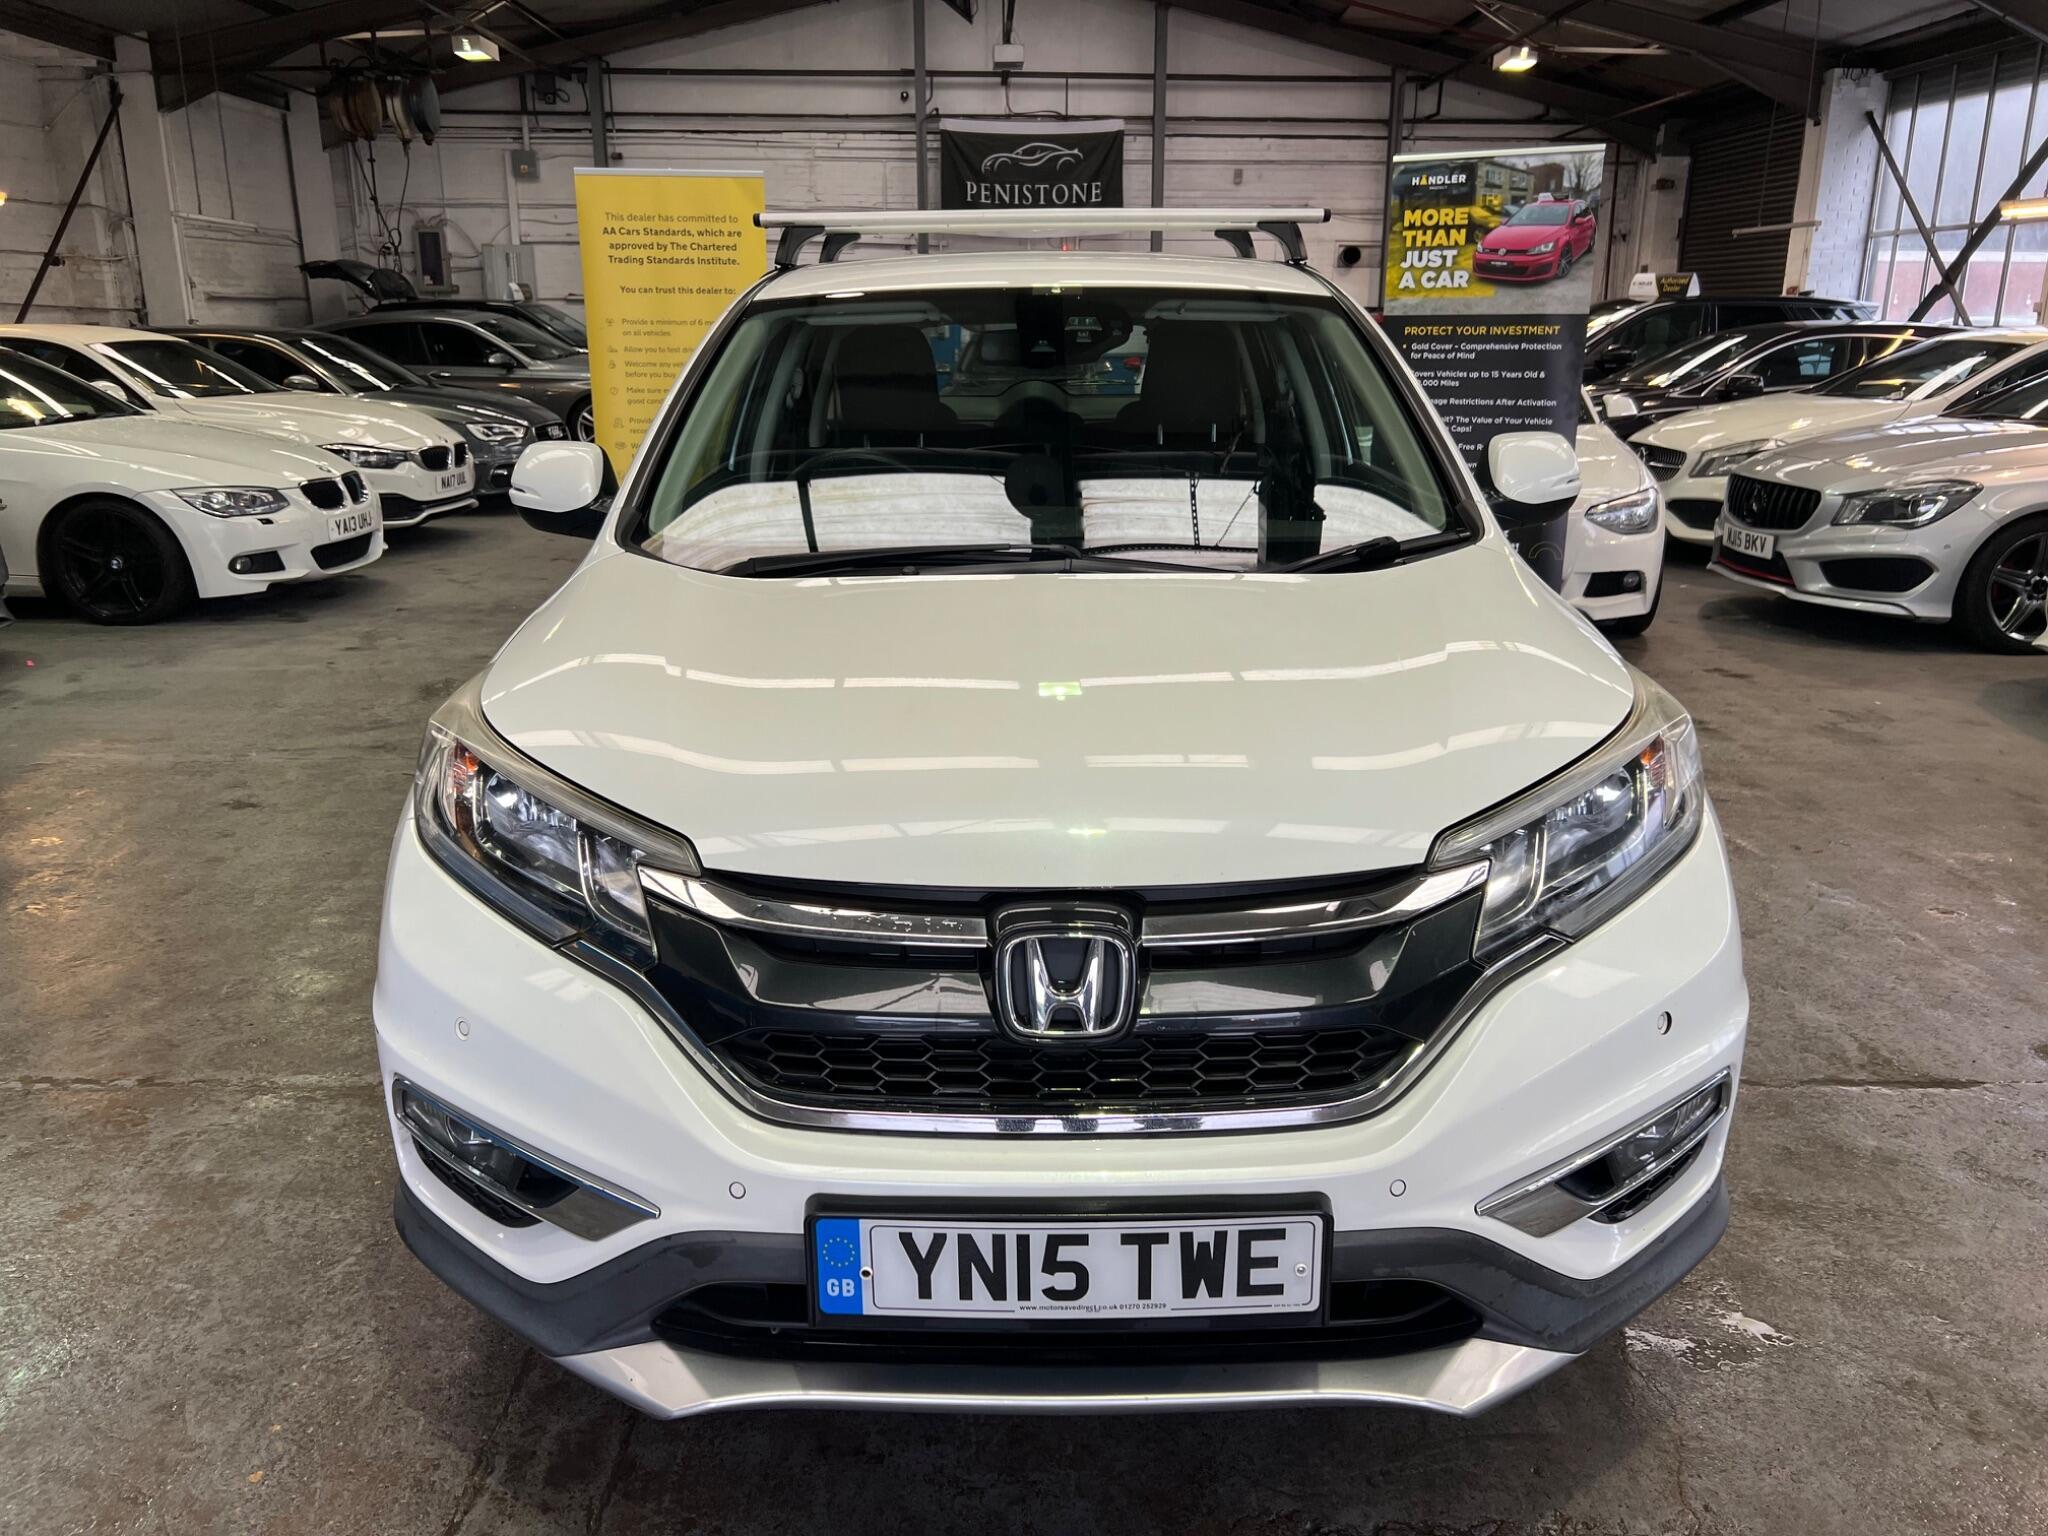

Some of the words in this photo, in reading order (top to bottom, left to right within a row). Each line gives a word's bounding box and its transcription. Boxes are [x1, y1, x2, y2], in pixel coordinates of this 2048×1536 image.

[1412, 174, 1467, 186] HANDLER
[965, 181, 1102, 205] PENISTONE
[604, 212, 625, 222] This
[626, 213, 656, 222] dealer
[658, 213, 674, 223] has
[676, 214, 726, 223] committed
[728, 215, 738, 224] to
[1403, 207, 1469, 227] MORE
[602, 227, 617, 236] AA
[618, 227, 641, 236] Cars
[643, 227, 695, 238] Standards,
[697, 229, 725, 238] which
[727, 230, 742, 238] are
[1402, 228, 1467, 248] THAN
[609, 242, 655, 252] approved
[656, 242, 668, 252] by
[669, 242, 687, 251] The
[690, 243, 737, 252] Chartered
[608, 255, 644, 265] Trading
[646, 256, 695, 265] Standards
[697, 256, 740, 266] Institute.
[1400, 249, 1458, 268] JUST
[1399, 271, 1415, 289] A
[1420, 270, 1470, 289] CAR
[620, 285, 636, 294] You
[655, 286, 676, 295] trust
[678, 286, 693, 295] this
[695, 286, 722, 295] dealer
[724, 286, 736, 295] to:
[621, 318, 648, 326] Provide
[689, 318, 697, 326] of
[697, 318, 703, 326] 6
[643, 329, 671, 337] vehicles
[1404, 326, 1453, 336] PROTECT
[1456, 326, 1487, 336] YOUR
[1489, 325, 1561, 335] INVESTMENT
[1411, 342, 1430, 351] Gold
[1431, 342, 1452, 351] Cover
[1460, 342, 1519, 352] Comprehensive
[1521, 342, 1562, 351] Protection
[1410, 351, 1421, 360] for
[1423, 352, 1445, 360] Peace
[1447, 351, 1455, 360] of
[1457, 351, 1475, 360] Mind
[1412, 370, 1434, 378] overs
[1436, 370, 1467, 378] Vehicles
[1469, 371, 1479, 380] up
[1480, 370, 1489, 378] to
[1491, 370, 1499, 378] 15
[1501, 370, 1522, 378] Years
[1523, 370, 1537, 378] Old
[1440, 379, 1460, 387] Miles
[1449, 397, 1494, 406] Restrictions
[1495, 398, 1516, 406] After
[1517, 398, 1557, 407] Activation
[1456, 416, 1469, 424] The
[1472, 416, 1492, 424] Value
[1494, 416, 1503, 424] of
[1504, 417, 1522, 425] Your
[1524, 417, 1553, 426] Vehicle
[334, 515, 357, 536] YA13
[1744, 533, 1767, 552] BKV
[898, 1231, 1090, 1302] YN15
[1120, 1228, 1287, 1300] TWE
[826, 1278, 855, 1297] GB
